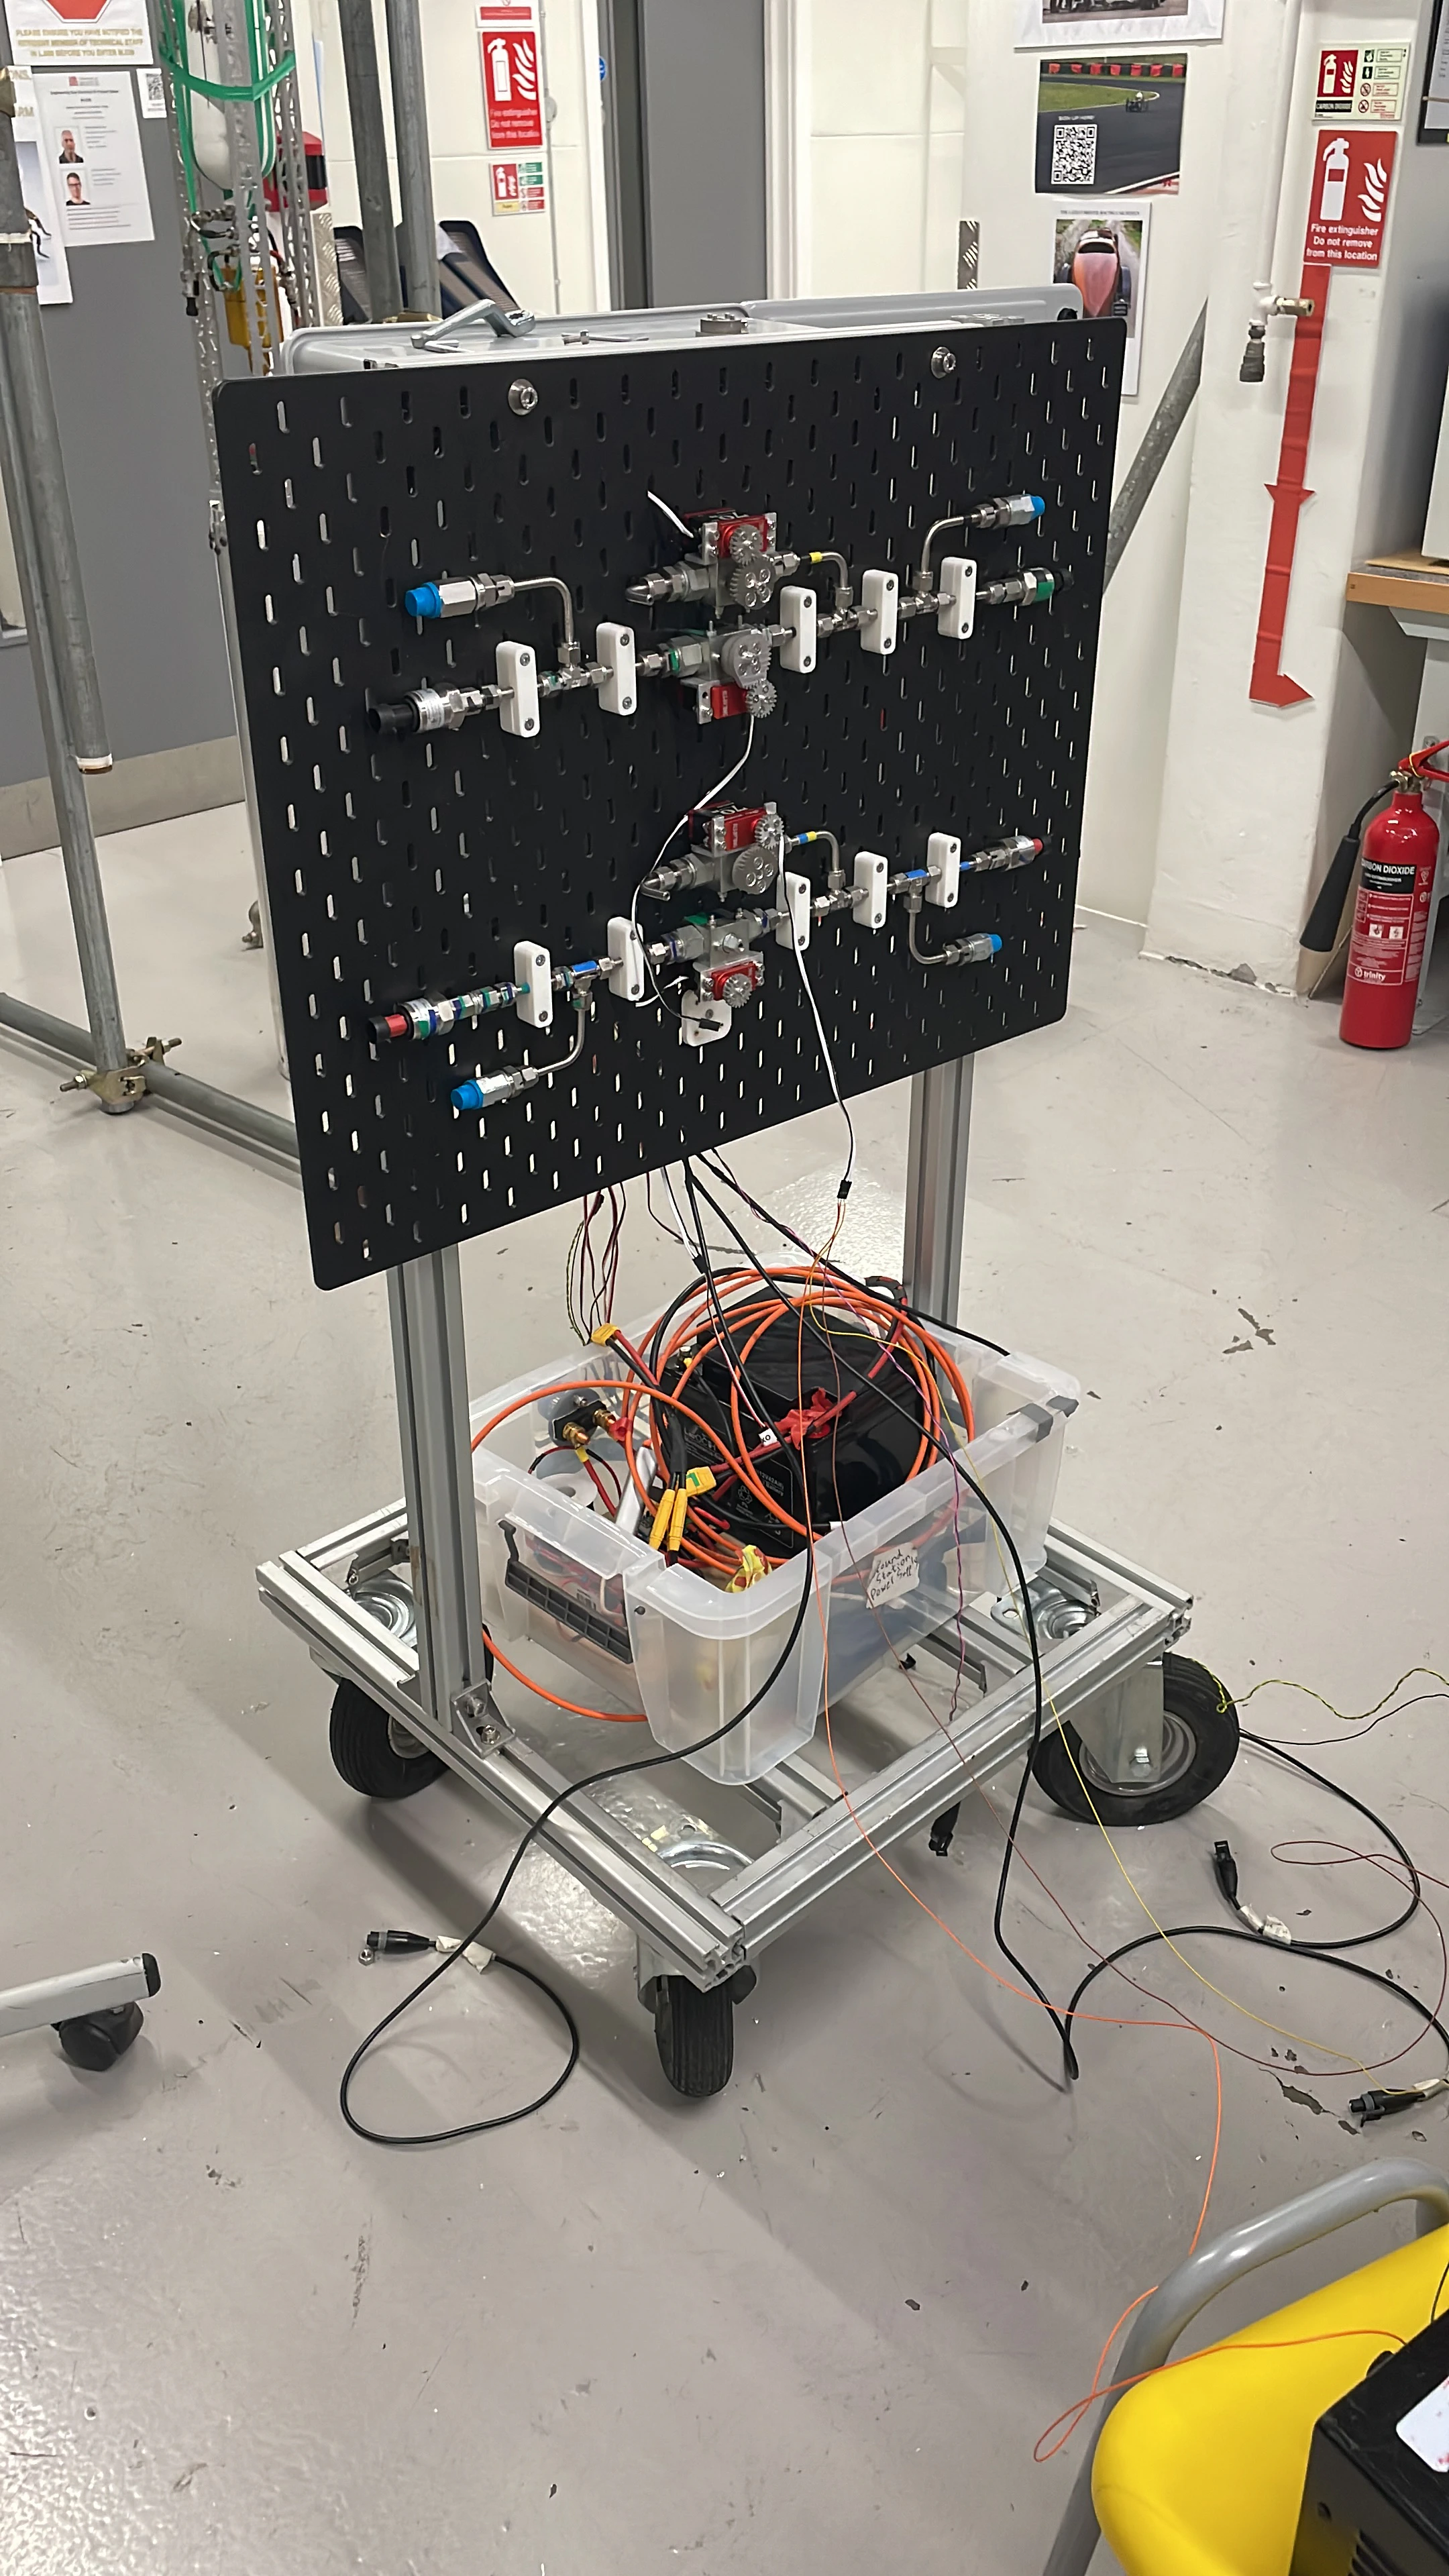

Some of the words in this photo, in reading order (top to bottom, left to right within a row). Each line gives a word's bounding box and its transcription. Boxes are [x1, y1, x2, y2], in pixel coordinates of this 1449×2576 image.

[1311, 223, 1326, 233] Fire
[1328, 225, 1379, 236] extinguisher
[1313, 235, 1325, 245] Do
[1327, 237, 1340, 246] not
[1342, 239, 1373, 248] remove
[1306, 248, 1325, 258] from
[1327, 249, 1342, 259] this
[1344, 250, 1377, 261] location
[1383, 865, 1415, 875] DIOXIDE
[1364, 970, 1386, 981] trinity
